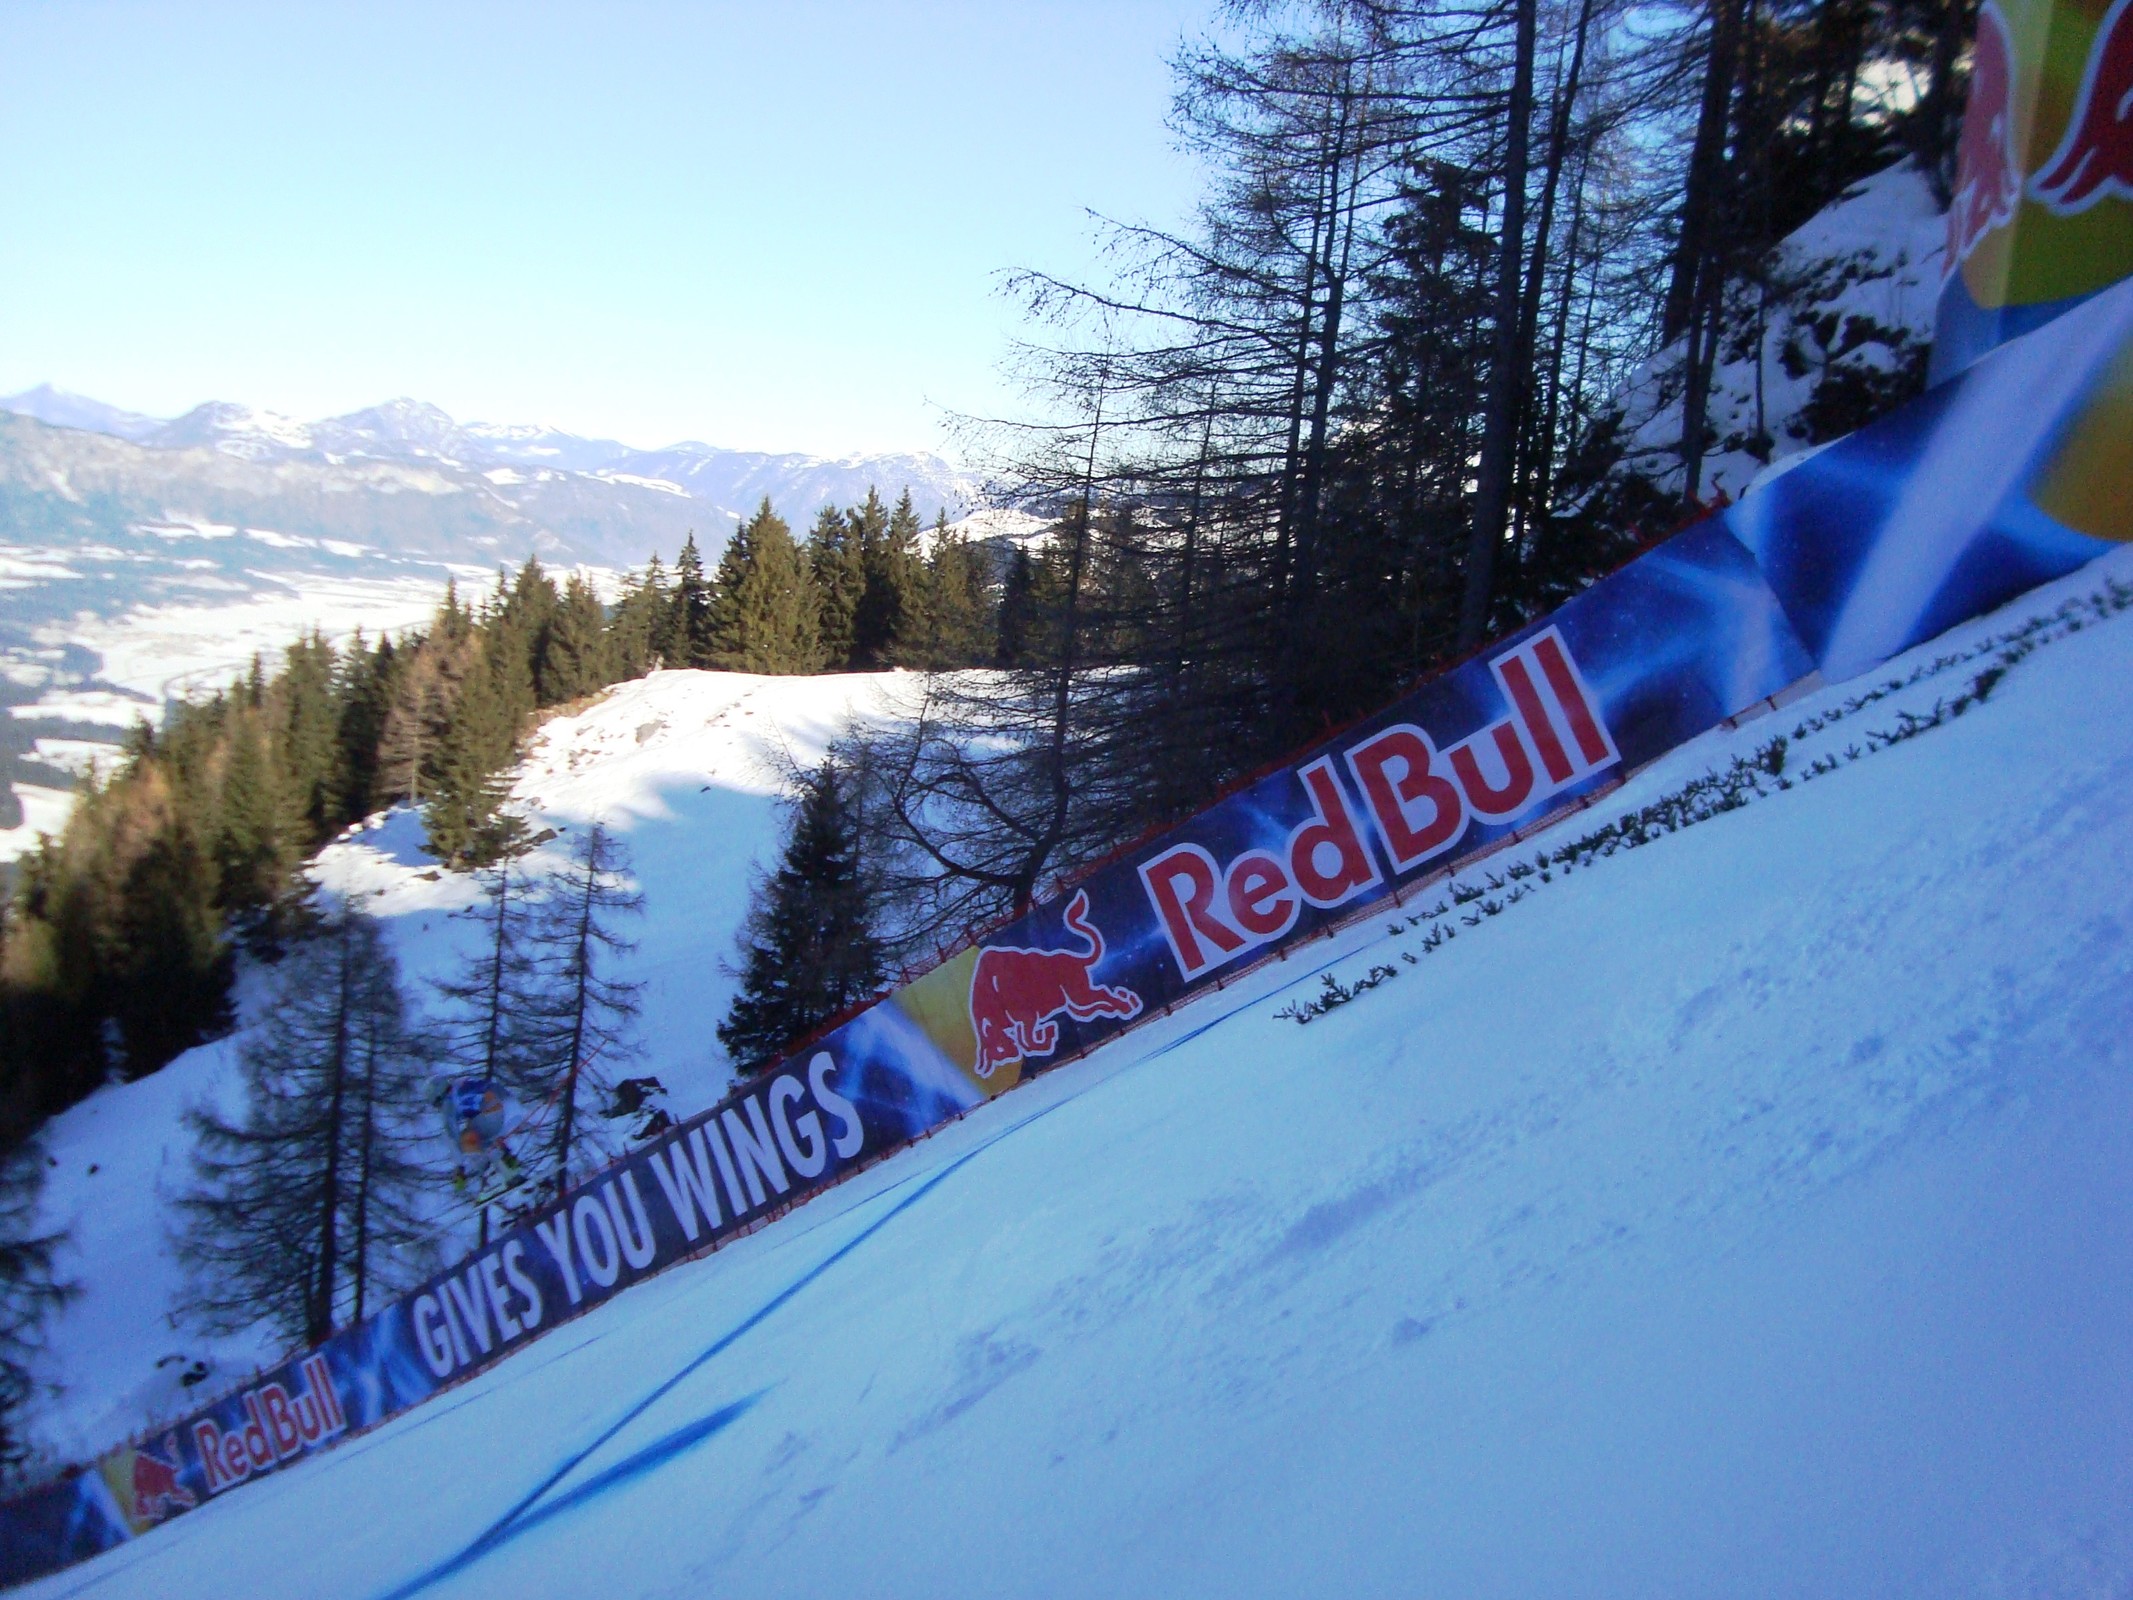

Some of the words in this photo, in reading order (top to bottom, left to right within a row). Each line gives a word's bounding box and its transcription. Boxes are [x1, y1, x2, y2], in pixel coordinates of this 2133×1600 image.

[1138, 755, 1383, 981] Red
[1344, 625, 1621, 874] Bull
[413, 1240, 544, 1378] GIVES
[536, 1170, 656, 1304] YOU
[648, 1051, 865, 1242] WINGS
[191, 1391, 279, 1493] Red
[259, 1352, 348, 1456] Bull
